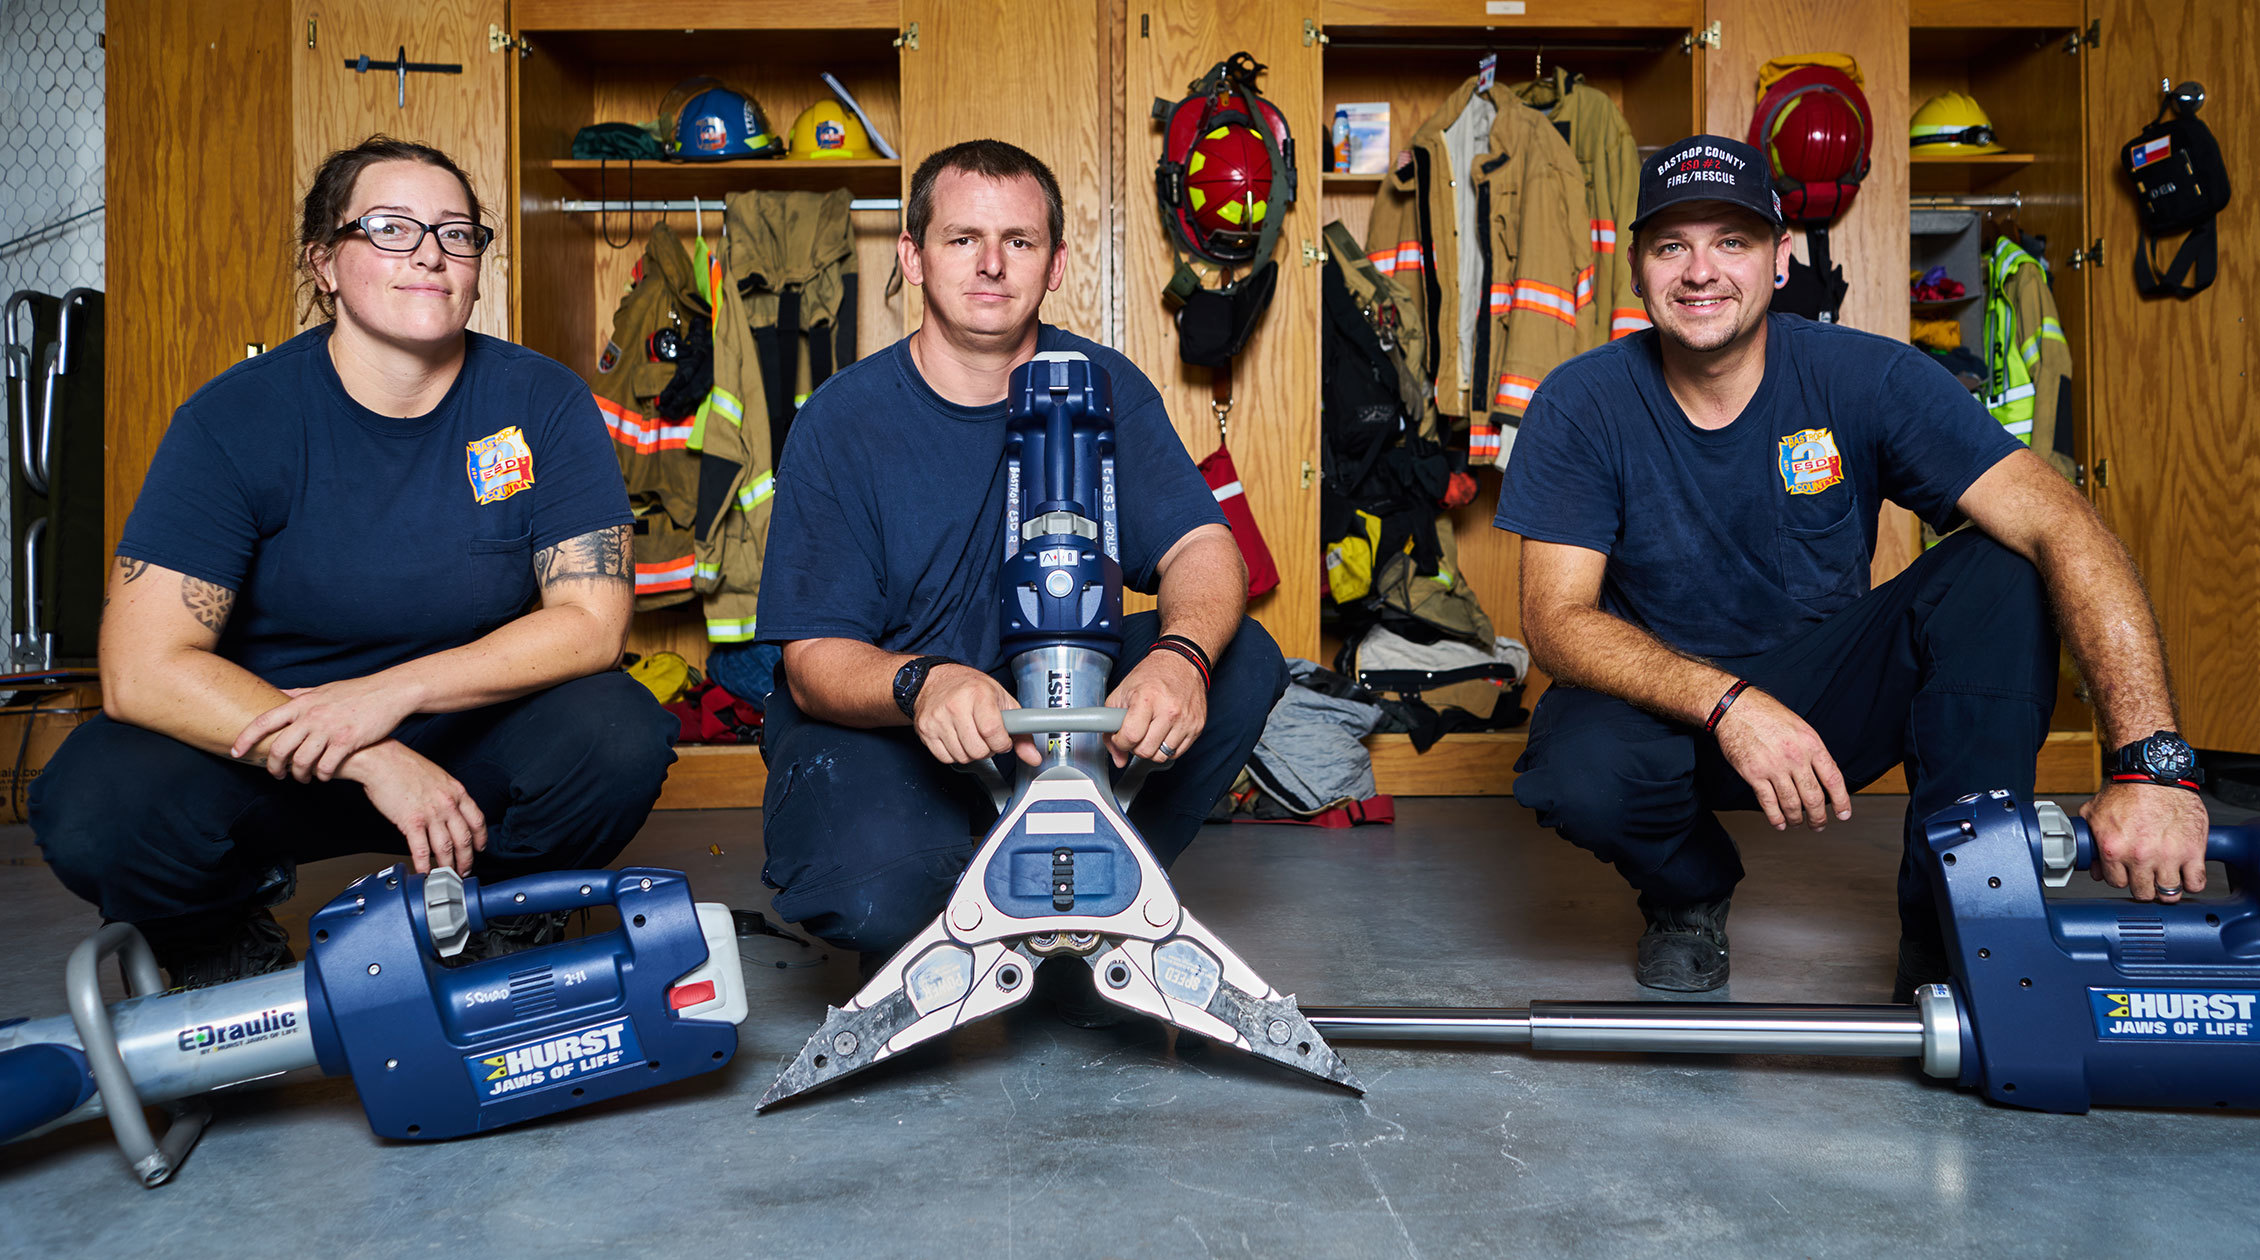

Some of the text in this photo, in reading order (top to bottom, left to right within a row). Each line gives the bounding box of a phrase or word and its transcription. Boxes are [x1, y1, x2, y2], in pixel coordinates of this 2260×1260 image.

[1657, 146, 1746, 176] BASTROP COUNTY
[1680, 158, 1721, 172] ESD #2
[1666, 171, 1736, 189] FIRE/RESCUE
[1788, 432, 1823, 449] BASTROP
[483, 459, 517, 480] ESD
[1794, 459, 1828, 472] ESD
[1008, 467, 1020, 504] BASTROP
[1795, 477, 1833, 492] COUNTY
[1103, 484, 1115, 512] ESD
[1008, 510, 1019, 532] ESD
[1104, 521, 1119, 563] ASTROP
[564, 970, 587, 987] 241
[1165, 966, 1201, 991] SPEED
[2129, 993, 2257, 1020] HURST
[217, 1041, 244, 1052] HURST
[245, 1035, 268, 1045] JAWS
[269, 1031, 280, 1039] OF
[281, 1027, 299, 1036] LIFE
[2109, 1020, 2249, 1036] JAWS OF LIFE
[505, 1023, 624, 1076] HURST
[489, 1051, 621, 1096] JAWS OF LIFE
